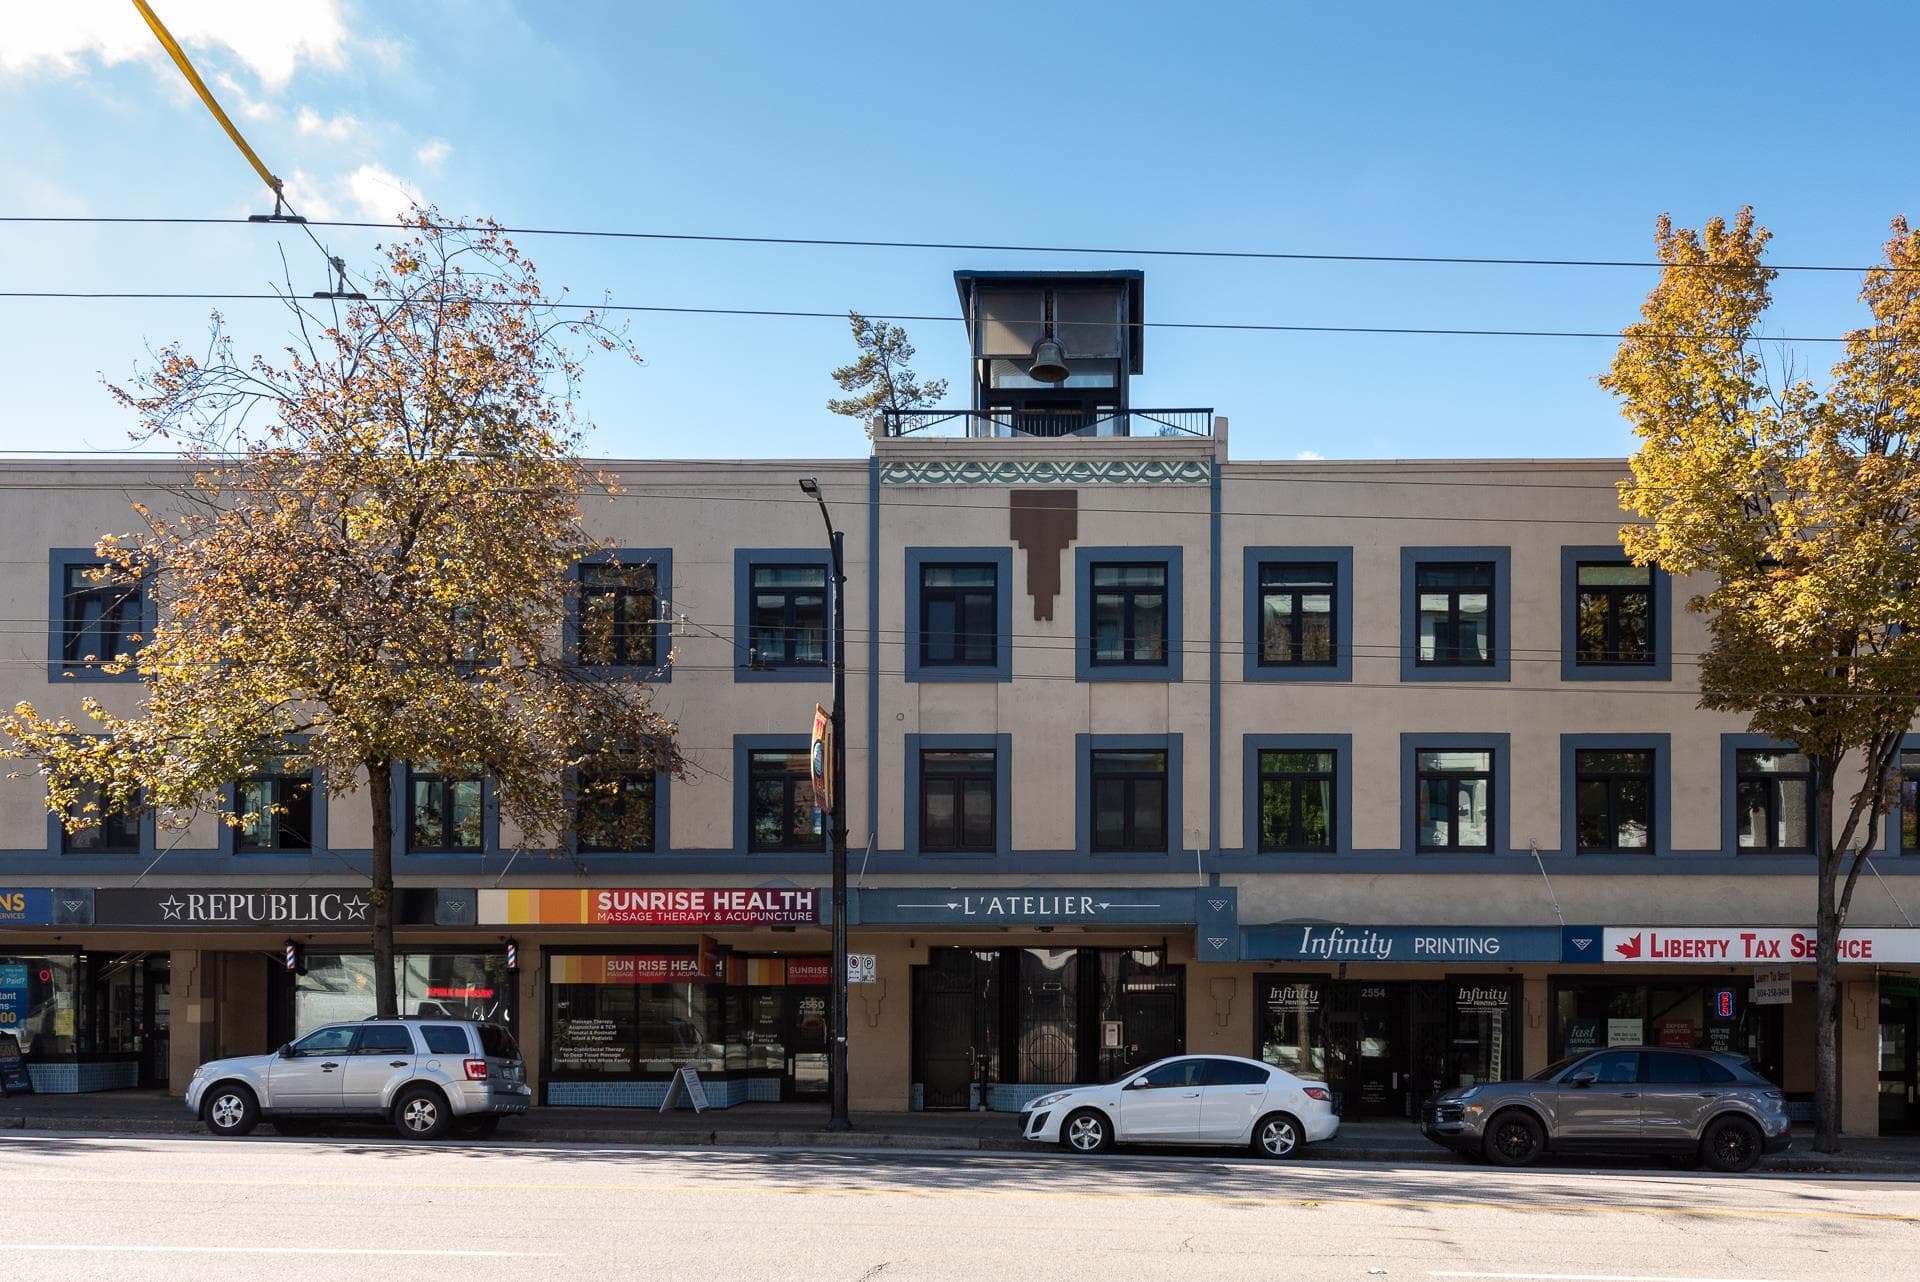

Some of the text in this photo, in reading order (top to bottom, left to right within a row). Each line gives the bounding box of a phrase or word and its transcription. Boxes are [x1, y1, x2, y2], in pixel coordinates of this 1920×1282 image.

[187, 894, 342, 921] REPUBLIC
[598, 892, 813, 911] SUNRISE HEALTH
[964, 896, 1096, 915] L'ATELIER
[598, 911, 813, 921] MASSAGE THERAPY & ACUPUNCTURE
[1299, 927, 1500, 960] Infinity PRINTING
[1650, 933, 1873, 958] LIBERTY TAX SEICE
[607, 960, 723, 971] SUN RISE HEAH
[789, 966, 828, 975] SUNRISE
[1270, 987, 1319, 1002] Infinity
[1361, 988, 1386, 998] 2554
[1458, 988, 1507, 1002] Infinity
[1571, 1025, 1596, 1038] fast
